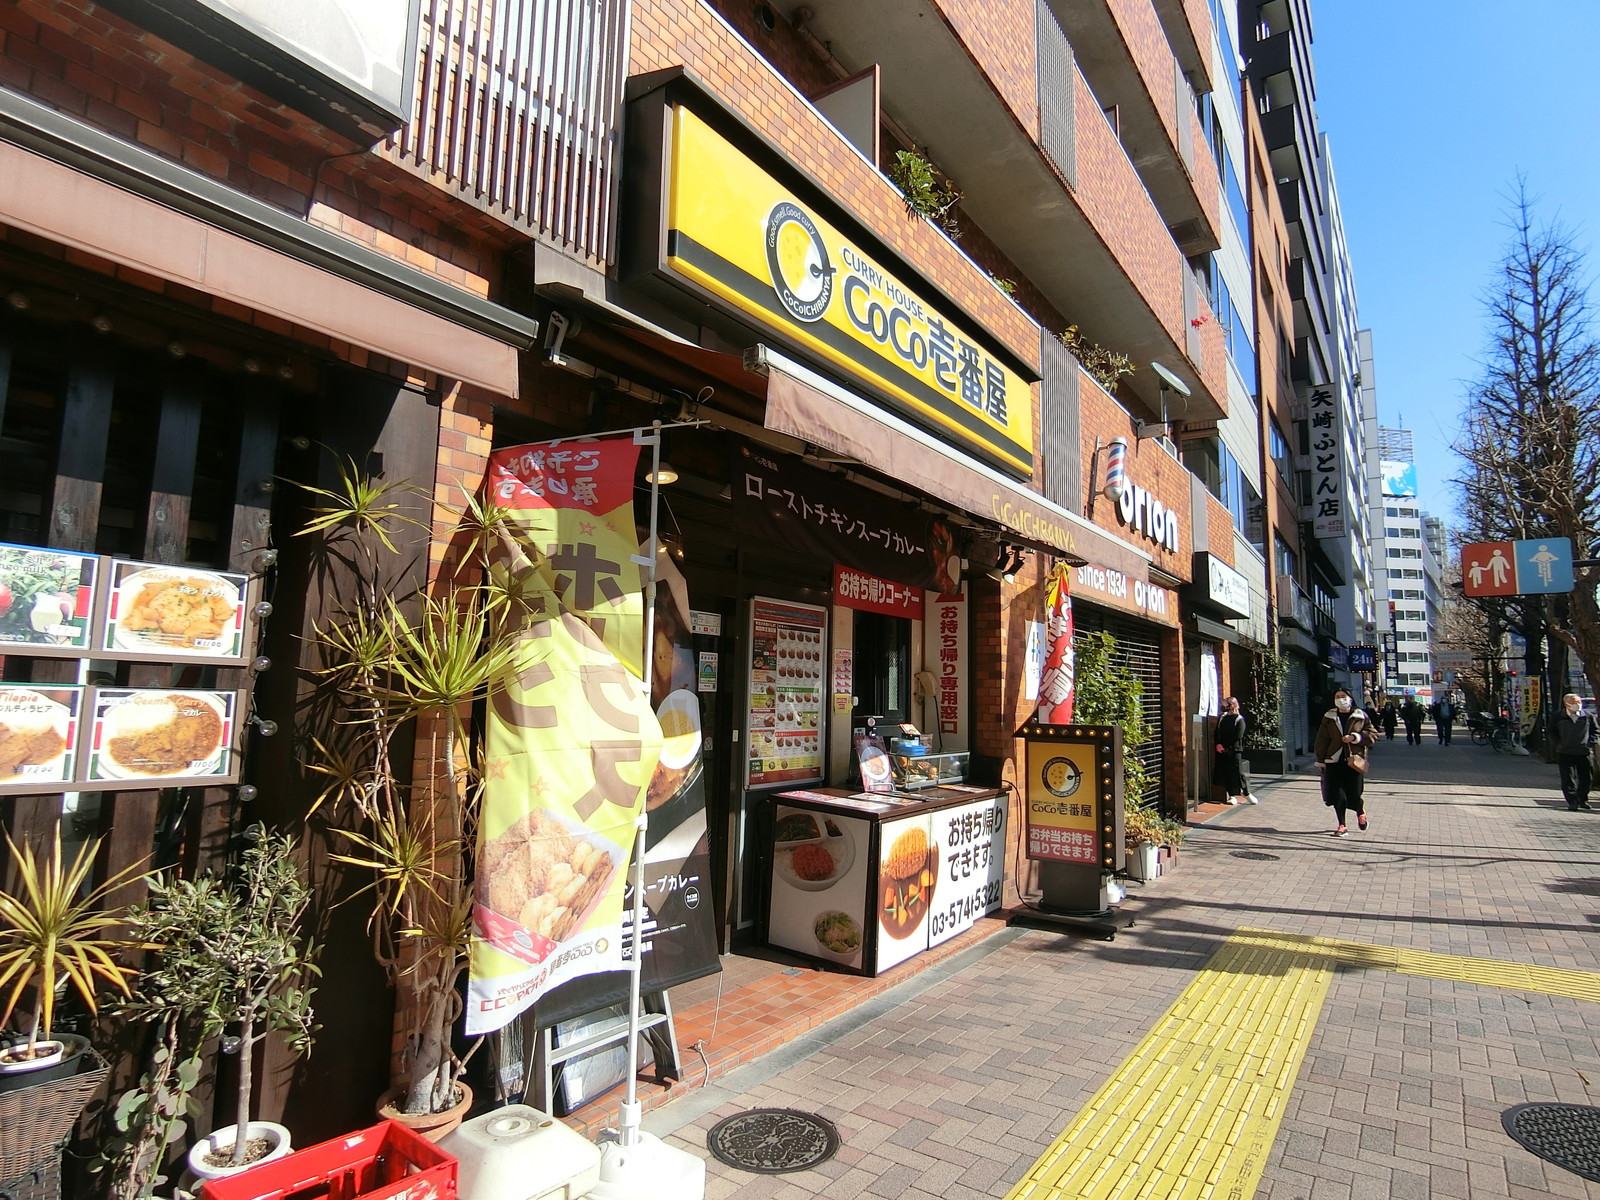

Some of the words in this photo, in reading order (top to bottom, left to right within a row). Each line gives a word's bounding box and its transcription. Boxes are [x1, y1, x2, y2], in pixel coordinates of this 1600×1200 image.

[784, 276, 831, 316] CoCoICHIBANYA
[843, 247, 883, 290] CURRY
[886, 280, 924, 323] HOUSE
[843, 275, 1008, 427] CoCo壱番屋
[1310, 390, 1340, 518] 矢崎ふとん店
[745, 473, 925, 556] ローストチキンスープカレー
[1120, 475, 1179, 553] orion
[23, 566, 46, 574] milk
[840, 571, 920, 608] お持ち帰りコーナー
[1078, 566, 1104, 592] since
[1106, 568, 1128, 599] 1934
[1134, 580, 1166, 614] orion
[940, 606, 958, 734] お持ち帰り専用窓口
[176, 697, 206, 708] Curry
[948, 806, 1003, 847] お持ち帰り
[1031, 802, 1092, 818] CoCo壱番屋
[1030, 828, 1092, 846] お弁当お持ち
[1030, 841, 1096, 862] 帰りできます。
[624, 875, 699, 900] ンープカレー
